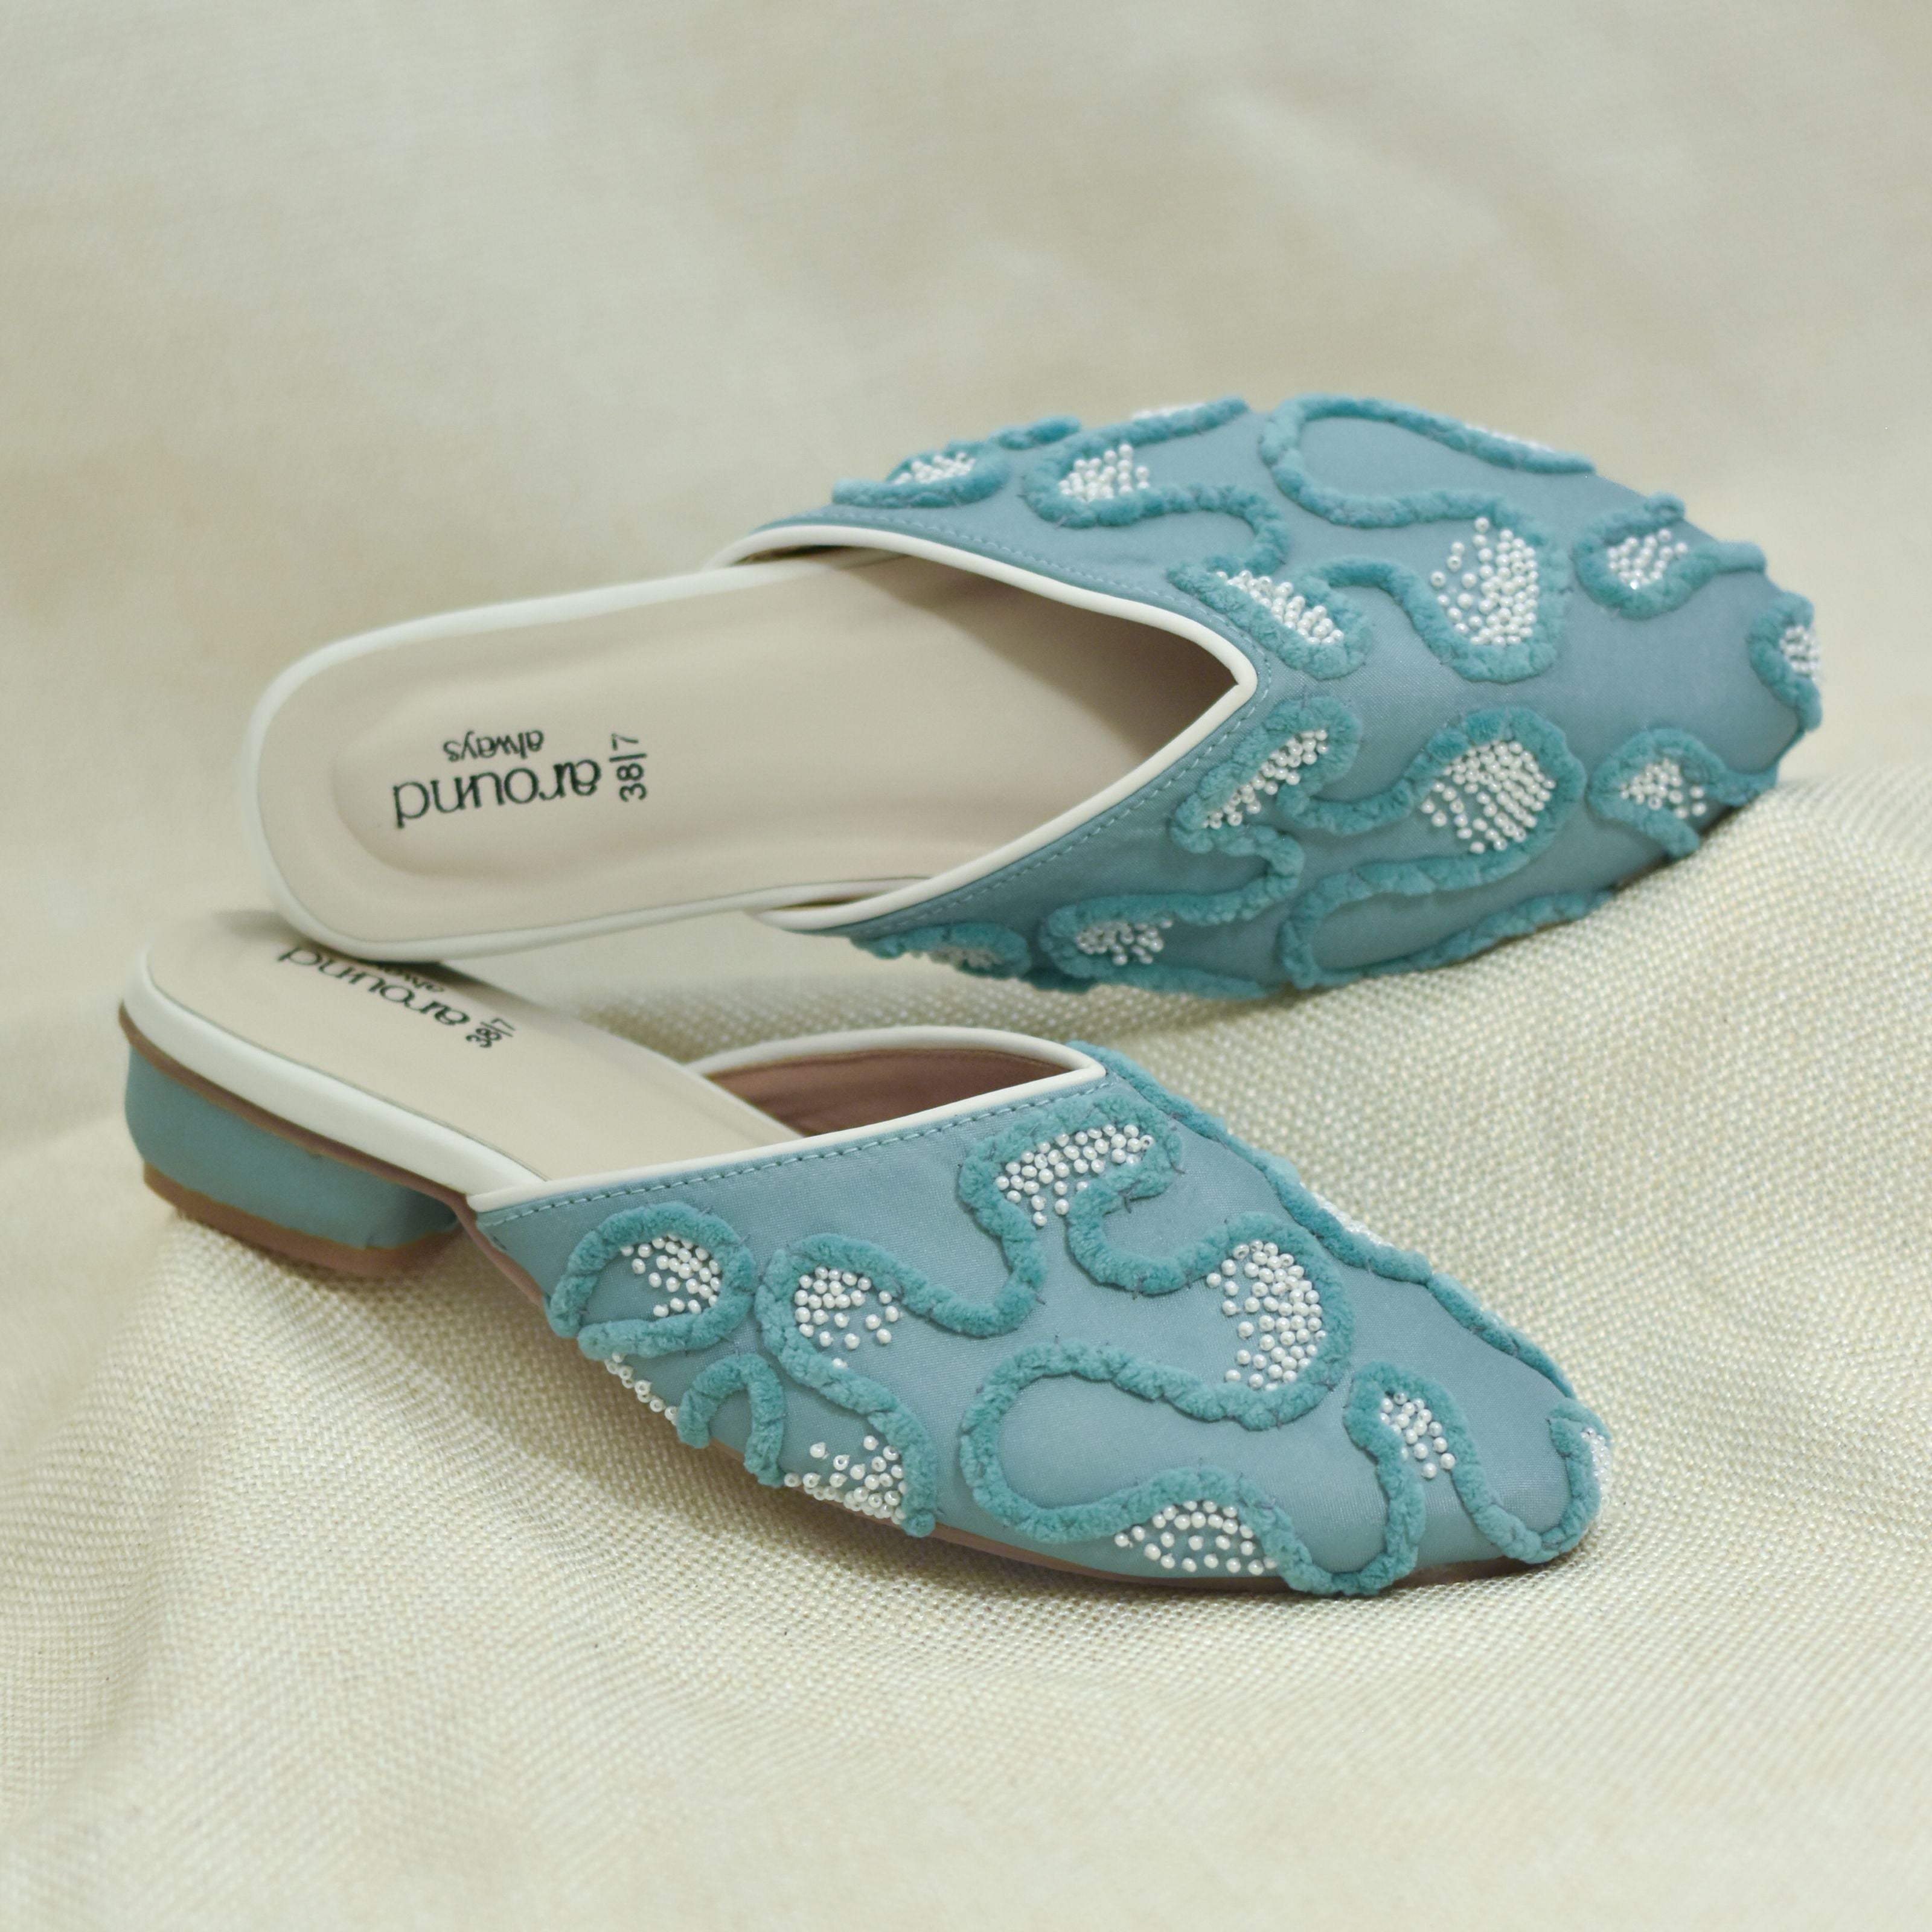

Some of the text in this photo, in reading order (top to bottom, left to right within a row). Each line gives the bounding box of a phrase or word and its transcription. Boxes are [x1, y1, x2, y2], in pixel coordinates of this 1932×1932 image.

[443, 730, 544, 762] always
[393, 759, 601, 829] around
[277, 947, 470, 1026] around
